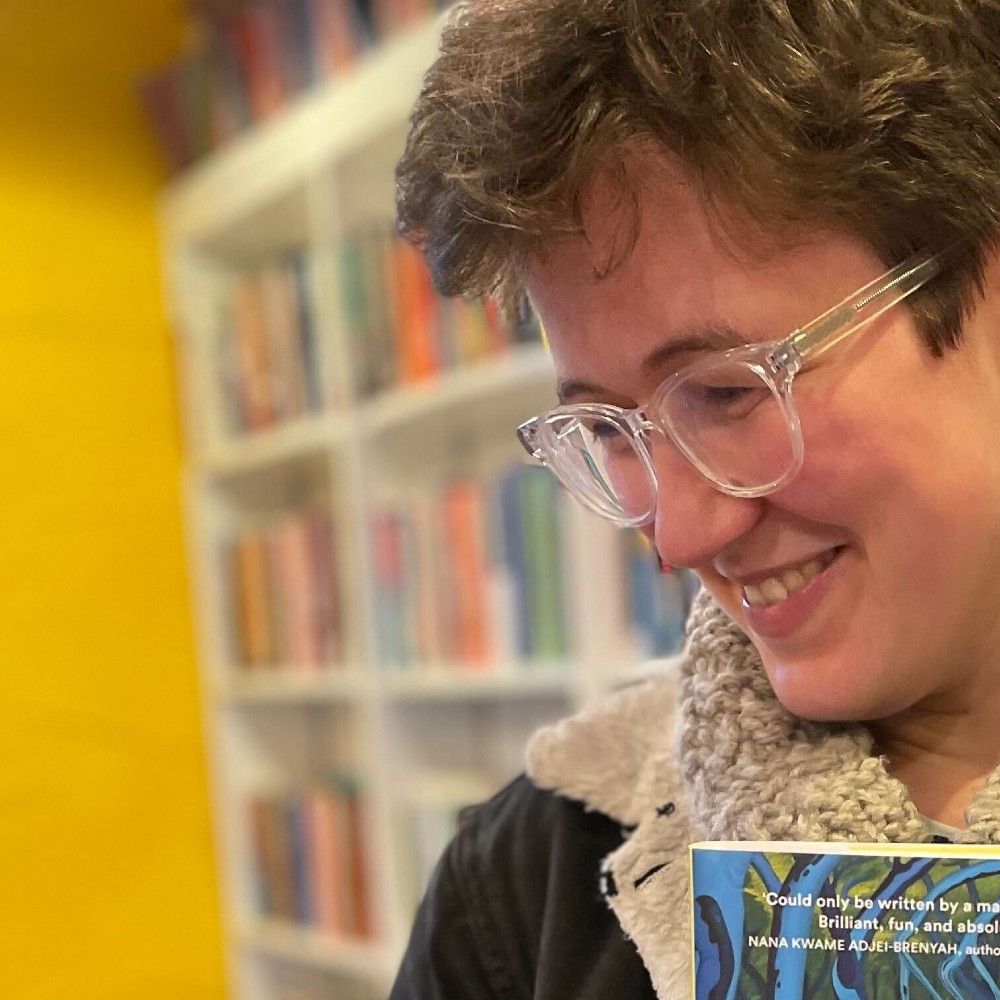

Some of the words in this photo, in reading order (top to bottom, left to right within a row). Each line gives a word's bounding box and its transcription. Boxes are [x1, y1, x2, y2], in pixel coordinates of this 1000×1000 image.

[817, 895, 850, 911] only
[854, 895, 874, 909] be
[878, 896, 935, 910] written
[940, 898, 959, 914] by
[963, 903, 972, 912] a
[818, 915, 884, 932] Brilliant,
[888, 917, 920, 933] fun,
[924, 919, 953, 932] and
[748, 936, 789, 948] NANA
[792, 938, 845, 951] KWAME
[848, 940, 962, 955] ADJEI-BRENYAH,
